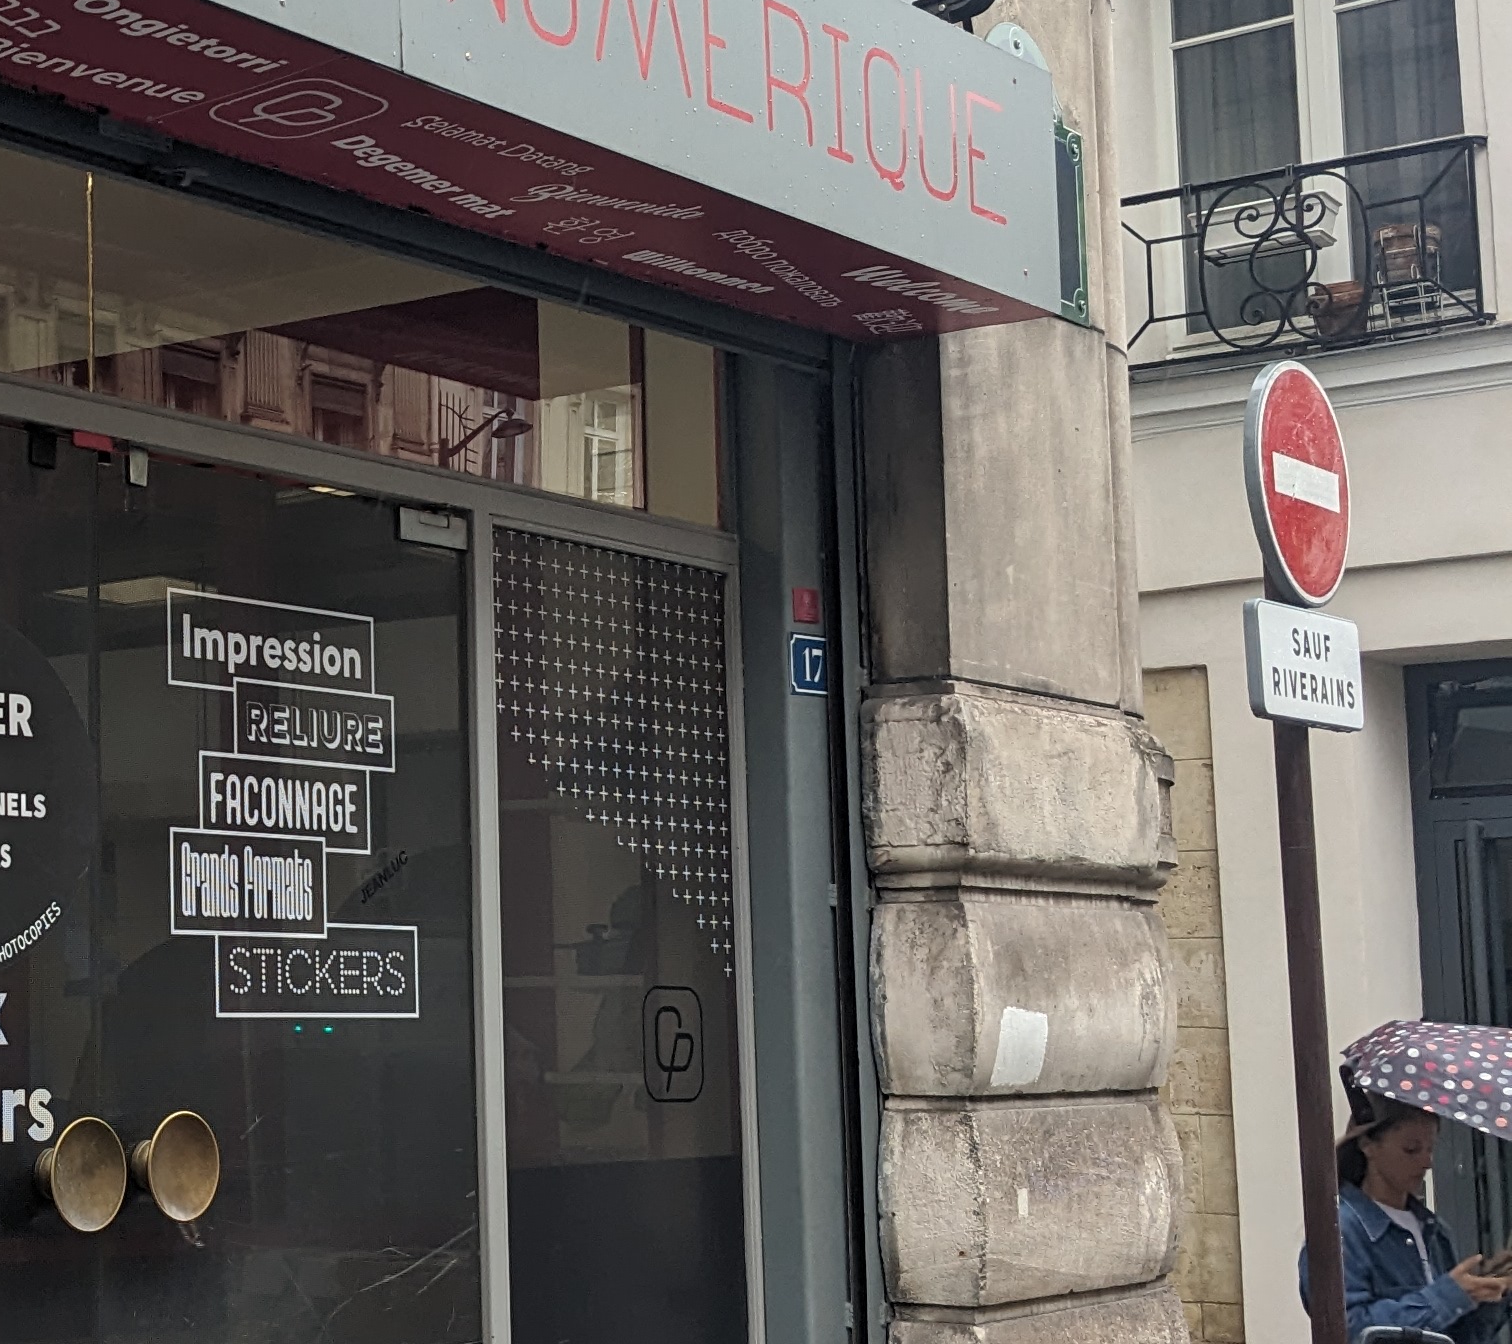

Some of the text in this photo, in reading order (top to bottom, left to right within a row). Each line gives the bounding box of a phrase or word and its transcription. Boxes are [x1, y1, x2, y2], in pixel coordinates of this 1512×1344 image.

[401, 115, 595, 176] Selamat Datang
[330, 135, 517, 220] Degemer mat
[542, 216, 636, 245] 환영
[621, 249, 776, 295] Willkommen
[840, 265, 1001, 316] Welcome
[182, 613, 362, 680] Impression
[802, 647, 823, 683] 17
[1292, 627, 1332, 663] SAUF
[1272, 666, 1356, 710] RIVERAINS
[245, 701, 385, 755] RELIURE
[210, 772, 359, 833] FACONNAGE
[181, 841, 239, 919] Grands
[229, 946, 406, 997] STICKERS
